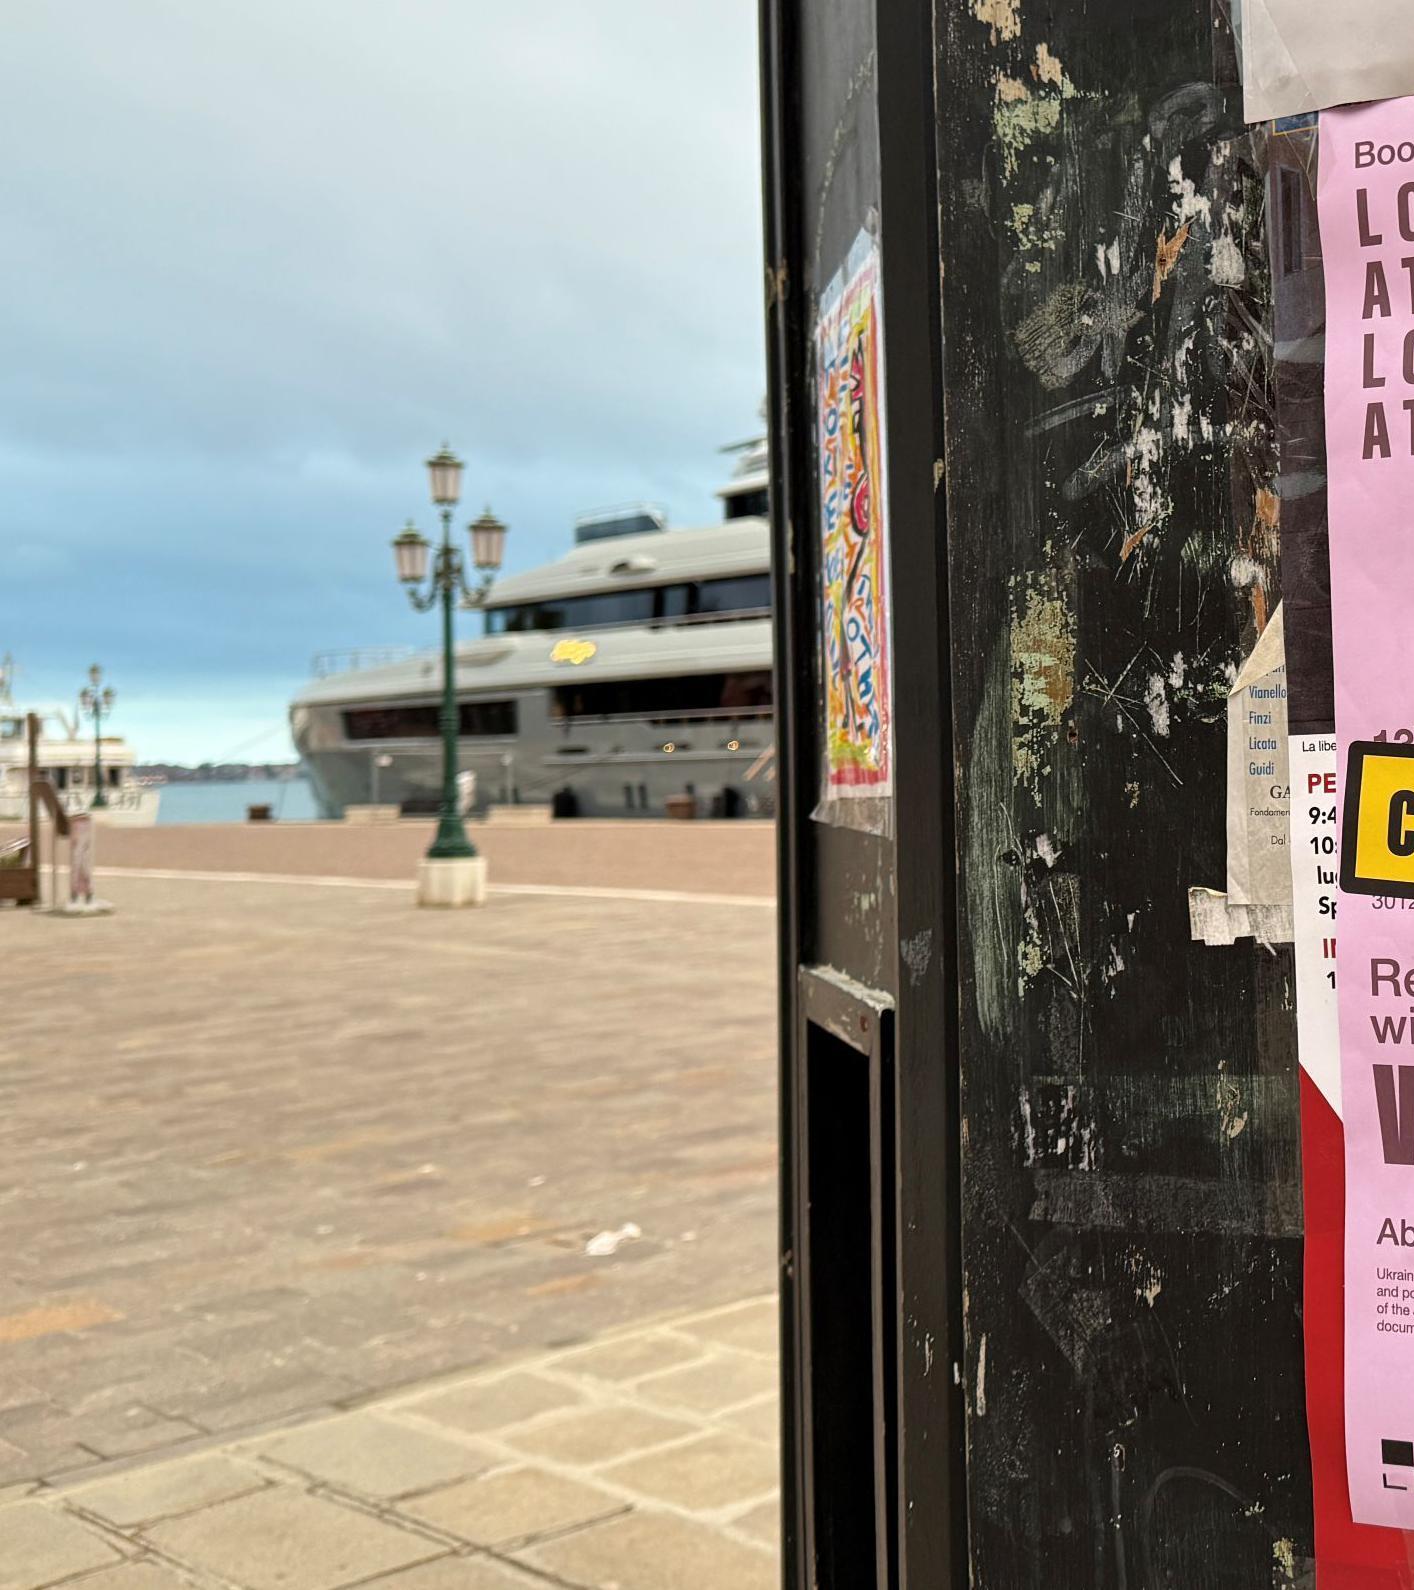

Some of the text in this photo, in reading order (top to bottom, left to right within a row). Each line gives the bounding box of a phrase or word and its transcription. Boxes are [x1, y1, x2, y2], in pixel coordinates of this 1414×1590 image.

[1249, 684, 1287, 699] Vianello
[1249, 711, 1272, 725] Finzi
[1249, 736, 1277, 750] Licata
[1302, 741, 1316, 753] La
[1249, 761, 1275, 776] Guidi
[1271, 834, 1286, 846] Dal
[1376, 1285, 1398, 1297] and
